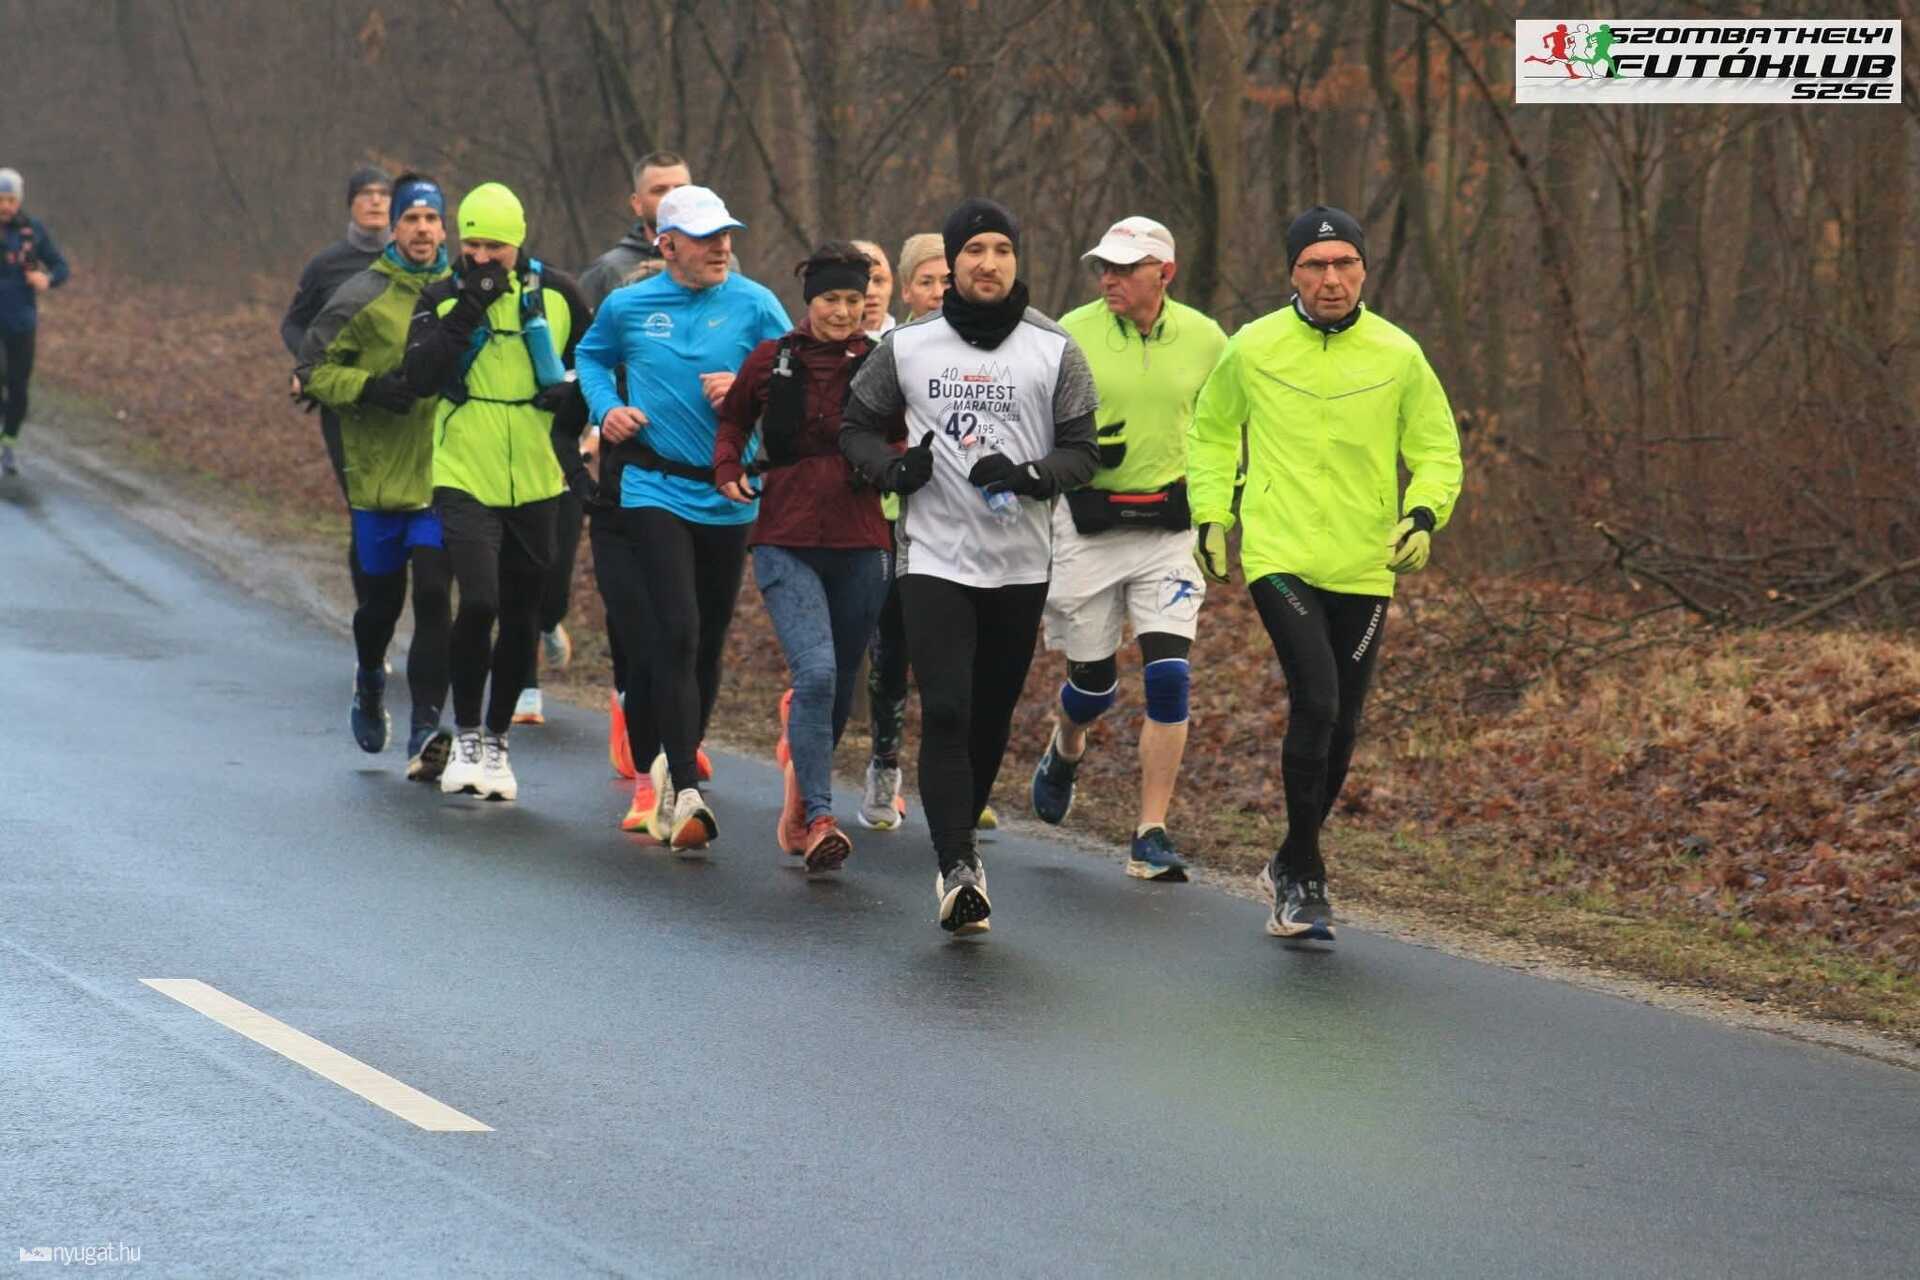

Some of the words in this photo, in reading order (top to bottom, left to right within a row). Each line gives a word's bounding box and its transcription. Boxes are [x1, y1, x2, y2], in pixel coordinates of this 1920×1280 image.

[953, 400, 1011, 413] MARATON
[945, 412, 978, 442] 42
[977, 424, 995, 434] 195
[1352, 603, 1383, 662] noname
